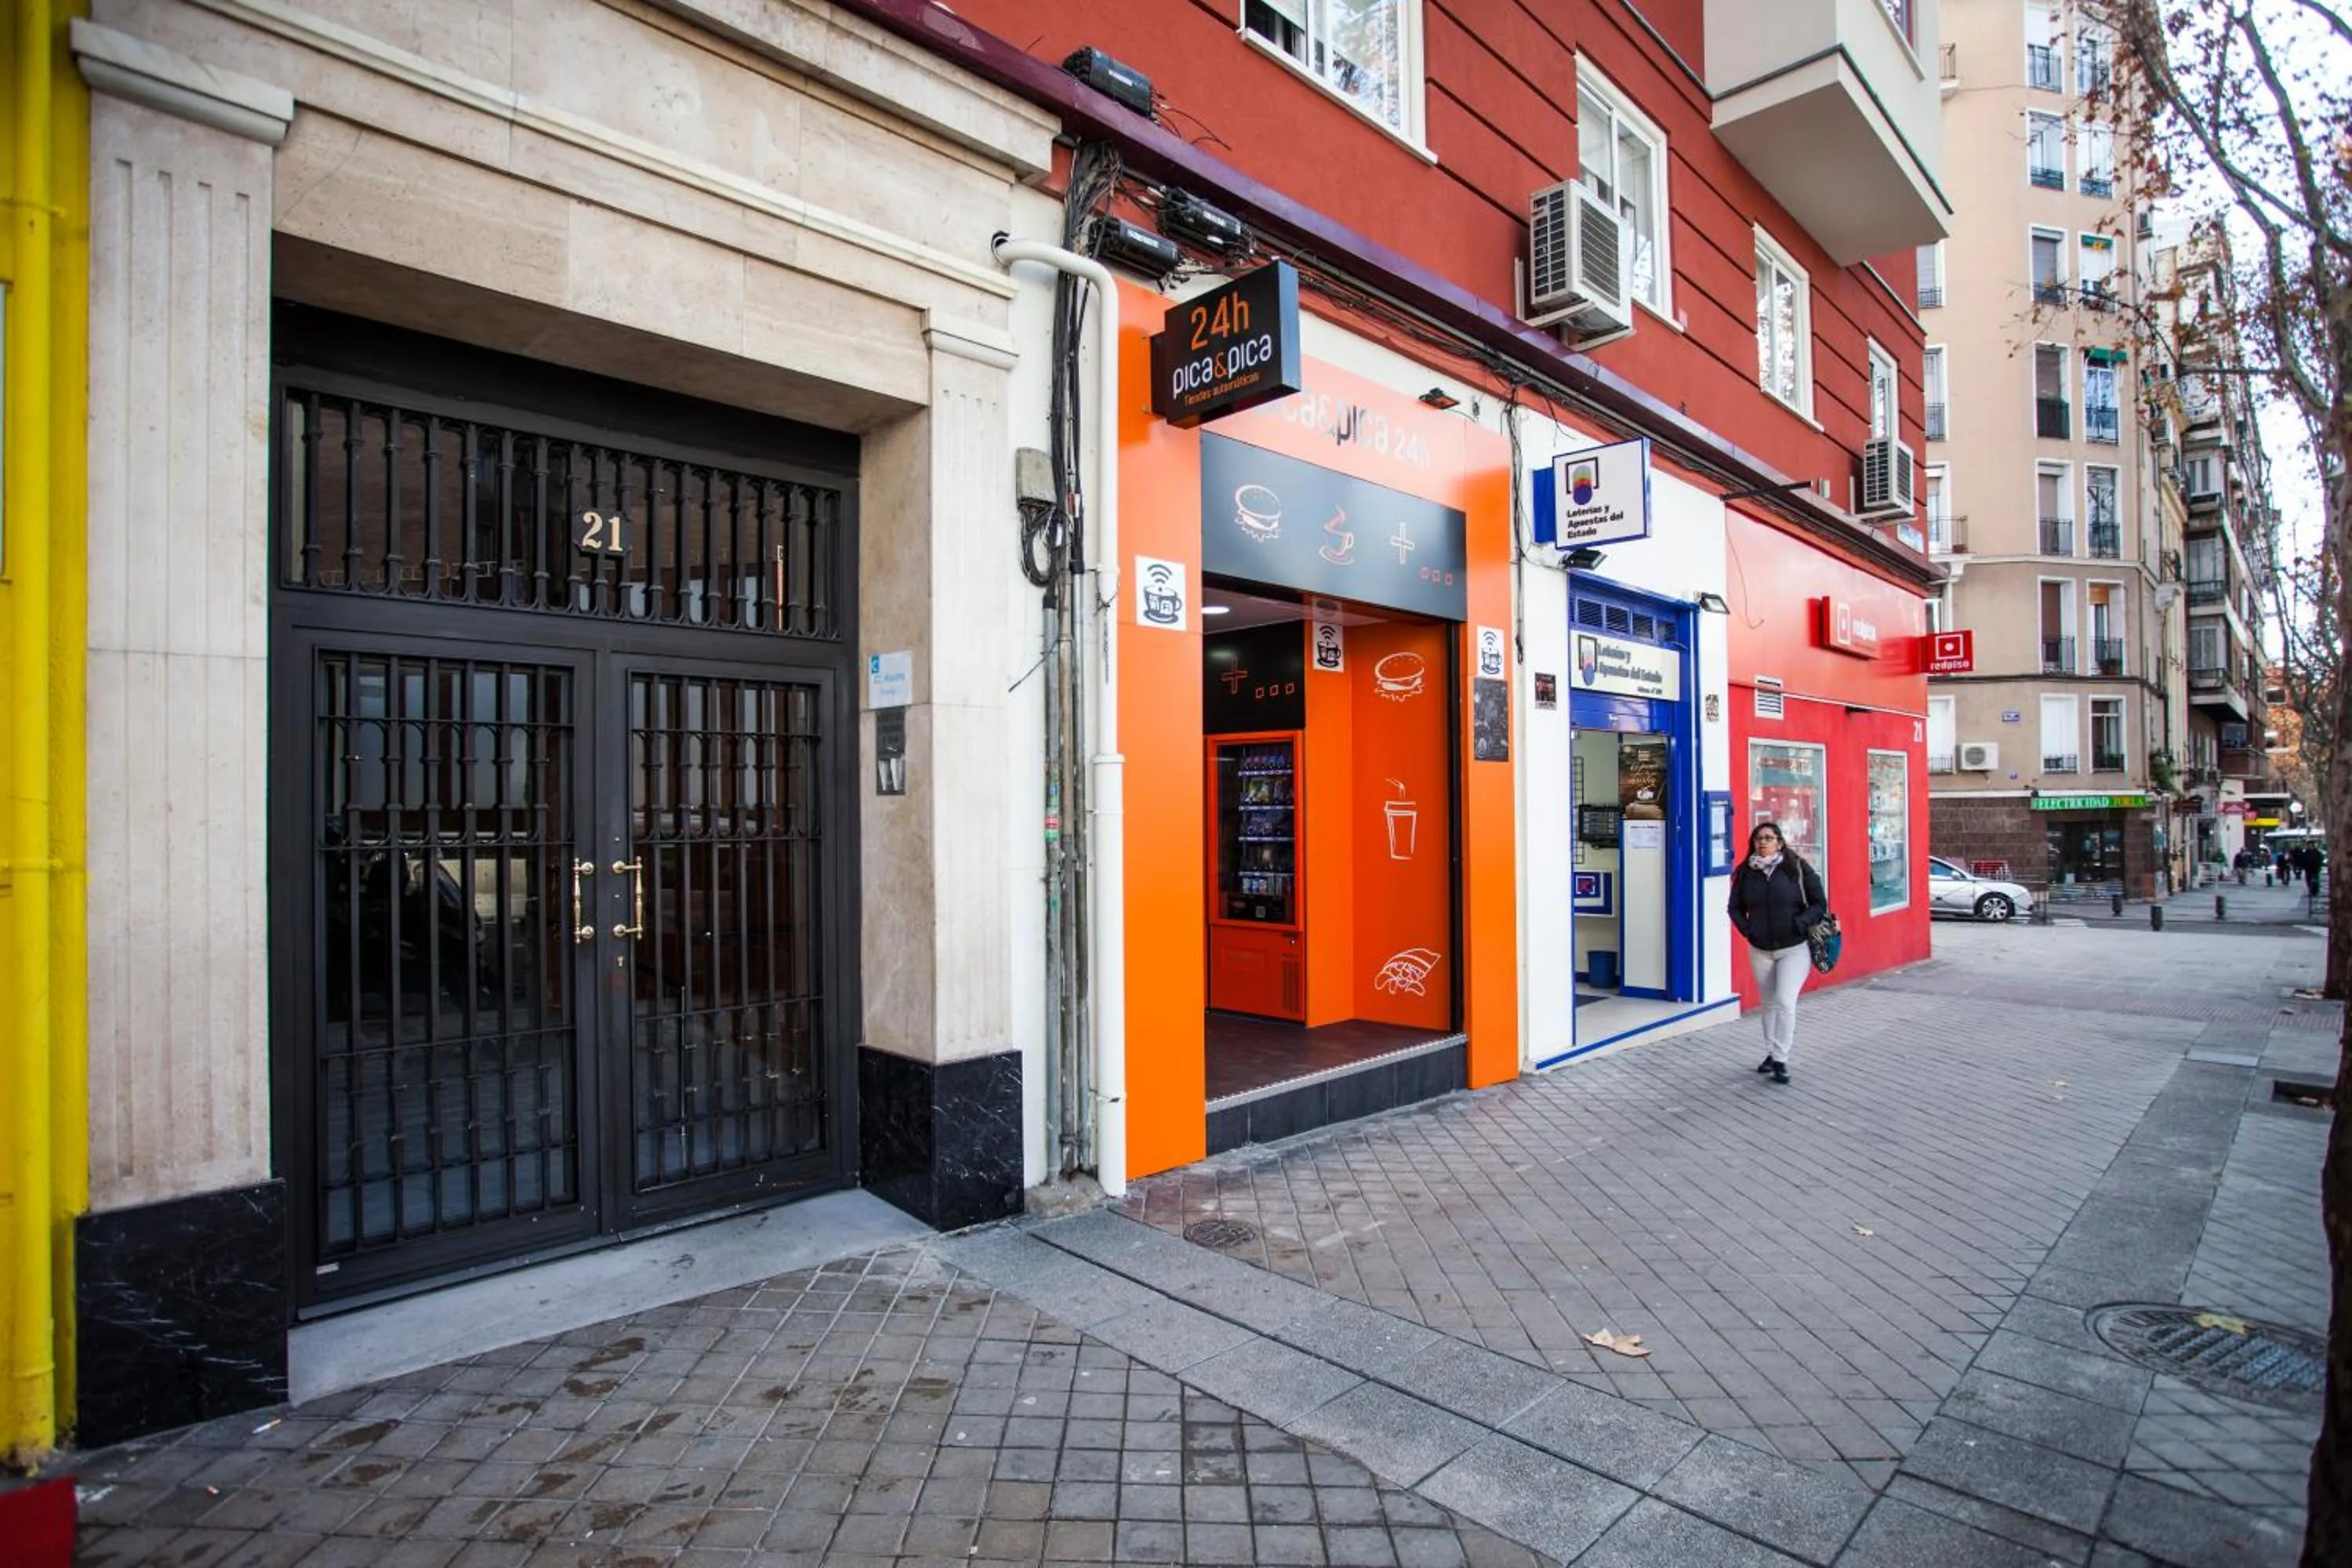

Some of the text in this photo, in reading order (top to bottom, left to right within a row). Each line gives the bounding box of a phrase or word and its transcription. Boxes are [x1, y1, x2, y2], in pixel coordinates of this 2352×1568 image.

[1190, 291, 1250, 350] 24h
[1173, 333, 1272, 400] pica&pica
[1278, 394, 1388, 454] ca&pica
[1567, 510, 1624, 529] Apuestas del
[1604, 505, 1610, 514] y
[583, 511, 624, 551] 21
[1567, 527, 1597, 539] Estado
[1930, 659, 1970, 671] redpiso
[1913, 720, 1923, 742] 21
